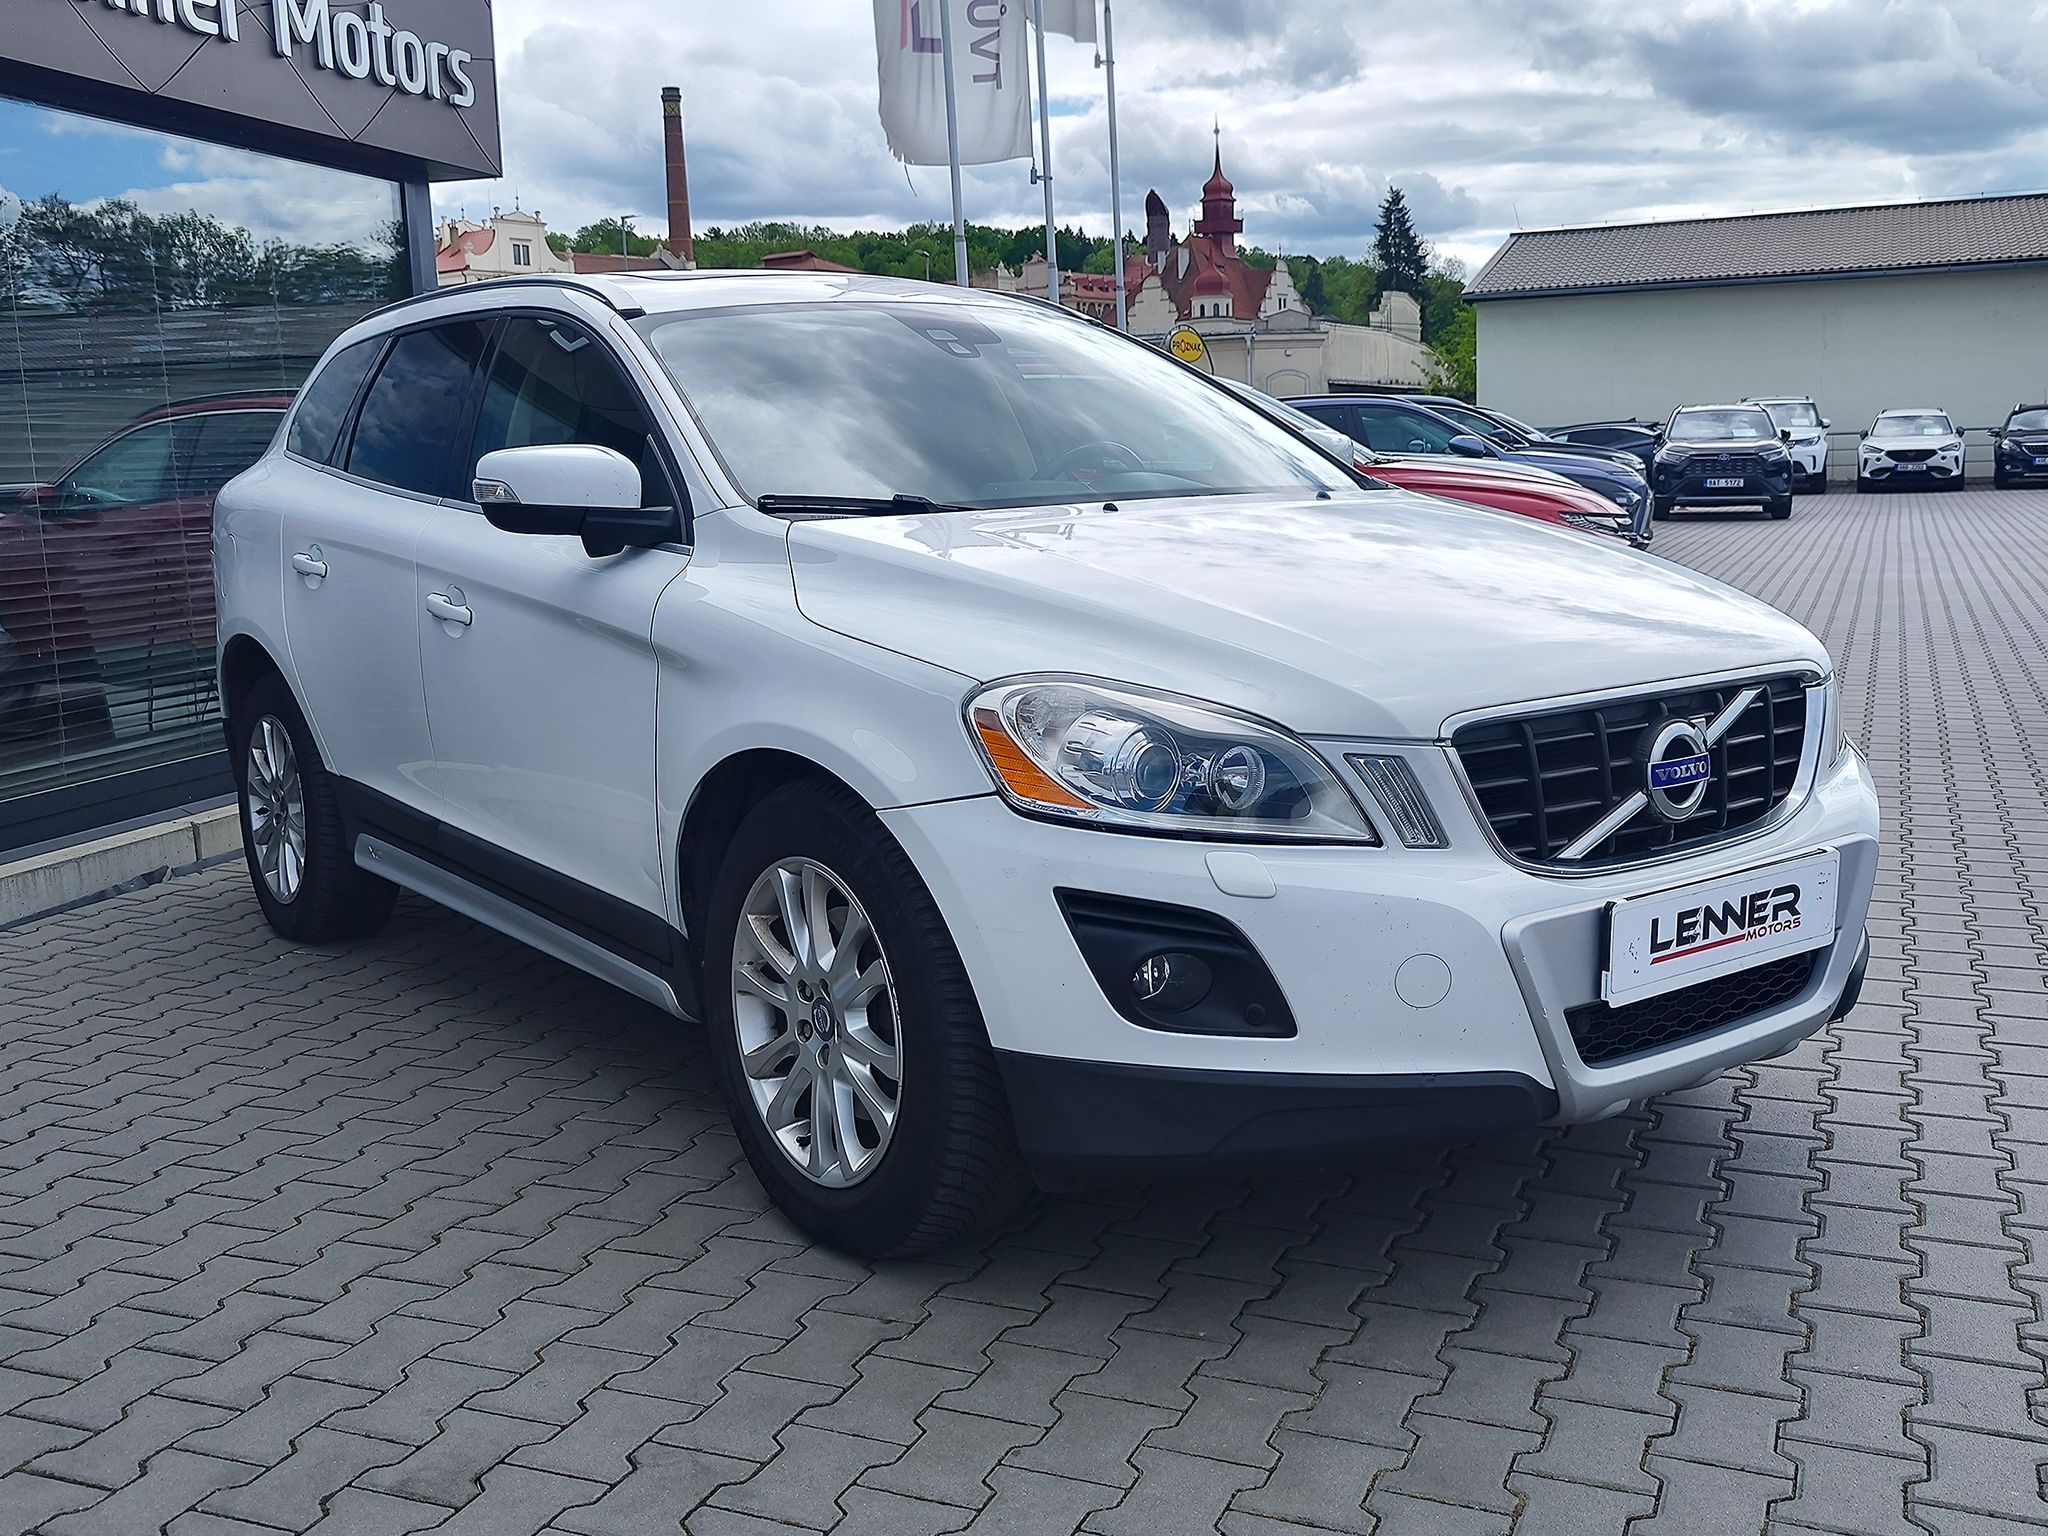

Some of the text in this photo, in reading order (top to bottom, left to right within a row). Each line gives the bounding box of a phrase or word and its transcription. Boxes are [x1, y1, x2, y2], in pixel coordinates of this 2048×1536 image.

[271, 0, 476, 109] Motors
[1656, 760, 1707, 782] VOLVO
[1650, 884, 1801, 954] LENNER
[1745, 916, 1802, 942] MOTORS
